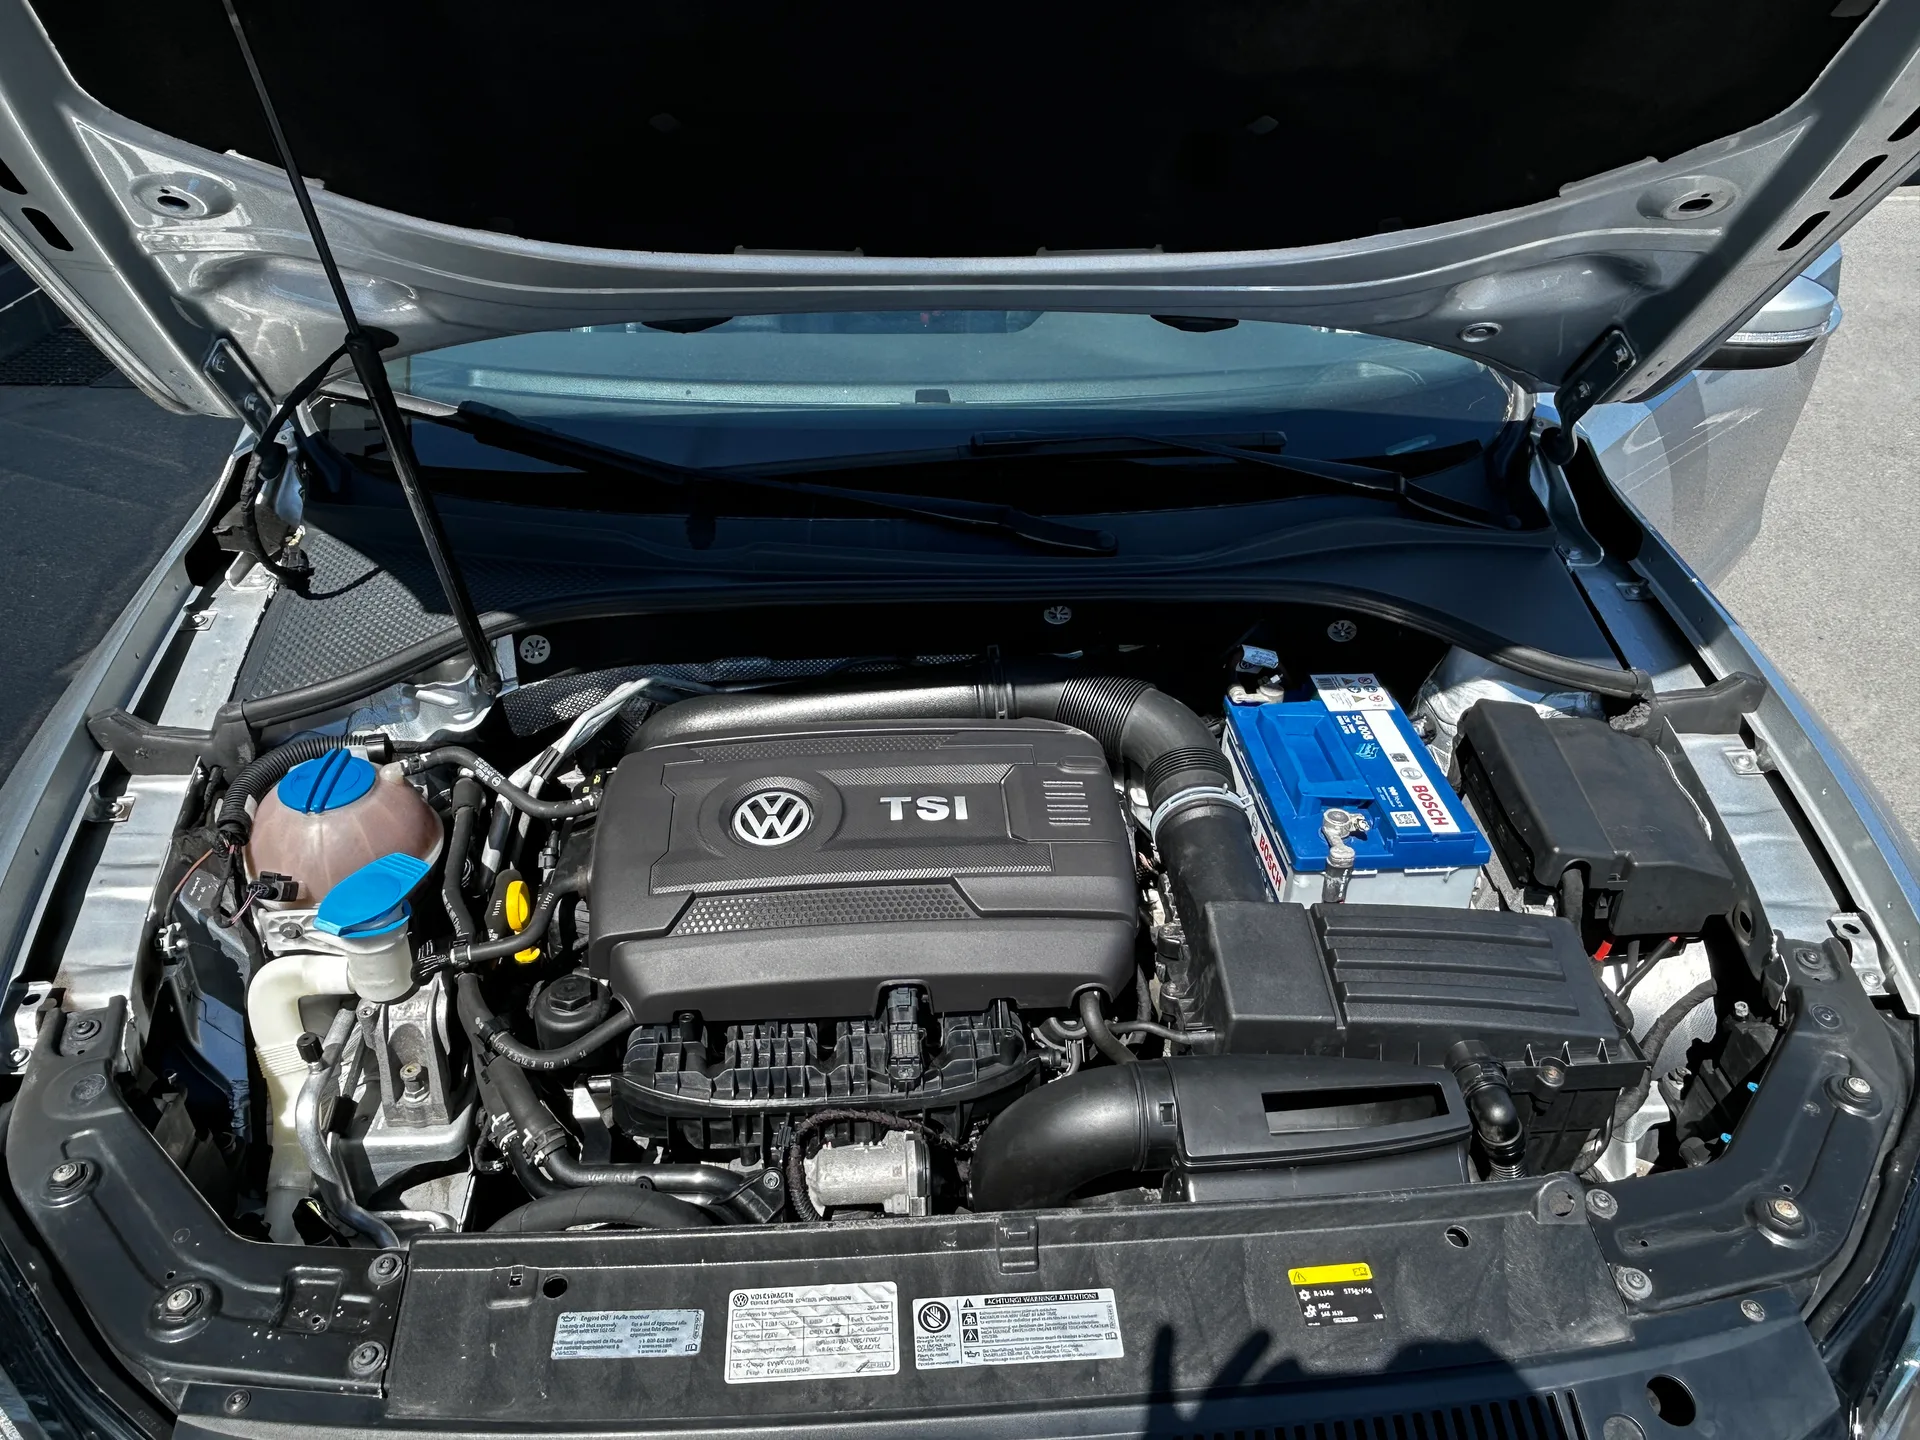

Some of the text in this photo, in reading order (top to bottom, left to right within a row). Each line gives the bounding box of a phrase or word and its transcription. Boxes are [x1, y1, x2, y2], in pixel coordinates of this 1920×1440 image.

[879, 795, 969, 821] TSI
[1411, 785, 1449, 826] BOSCH
[1259, 832, 1282, 892] BOSCH
[543, 1061, 555, 1069] 03
[750, 1292, 794, 1300] VOLKSWAGEN
